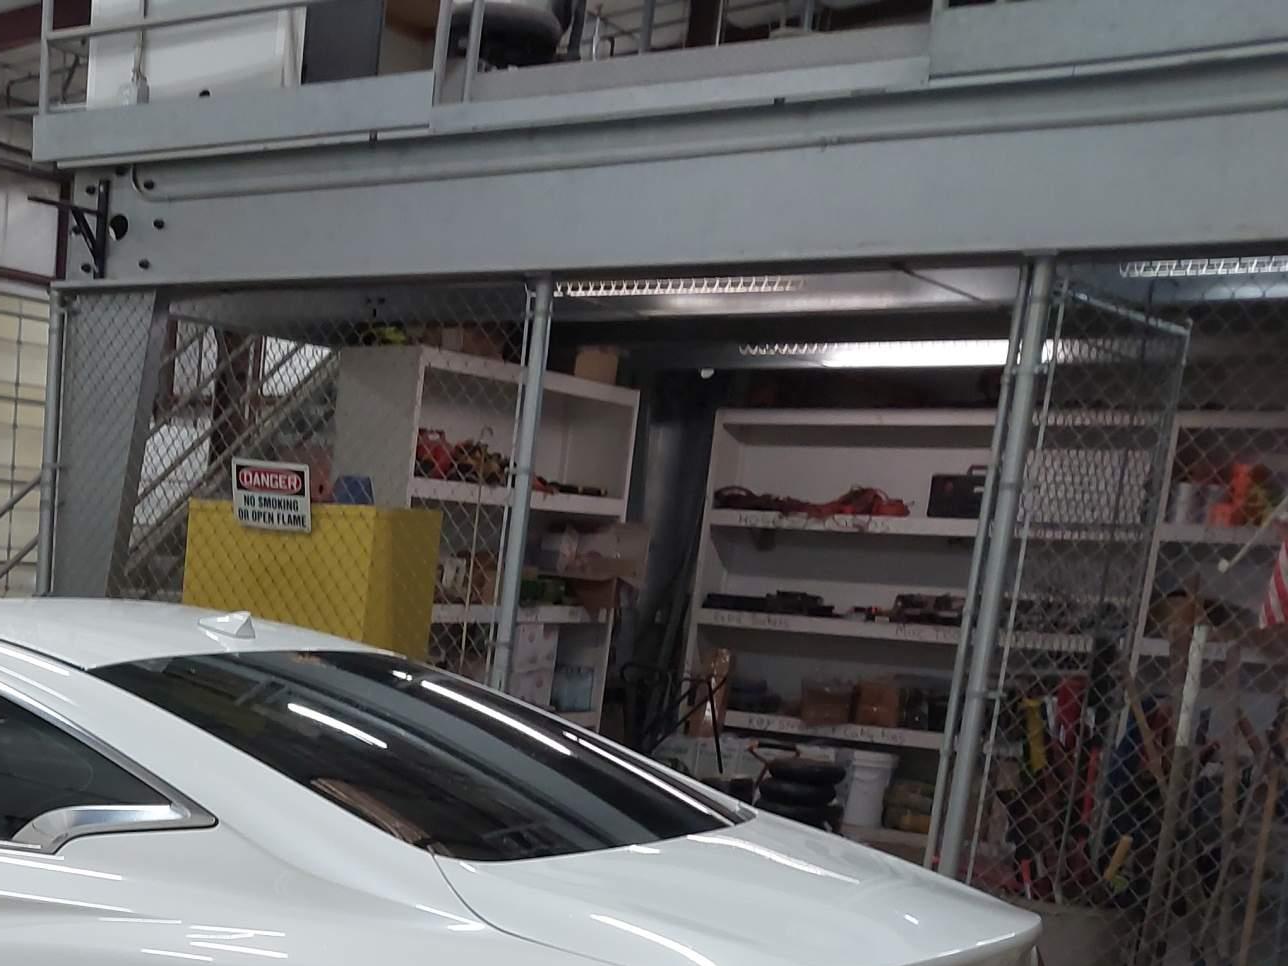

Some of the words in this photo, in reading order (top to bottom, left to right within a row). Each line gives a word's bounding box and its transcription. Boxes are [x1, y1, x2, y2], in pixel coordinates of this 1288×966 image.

[243, 471, 297, 491] DANGER
[243, 494, 256, 507] NO
[258, 496, 299, 513] SMOKING
[238, 507, 250, 521] OR
[252, 510, 275, 525] OPEN
[276, 513, 307, 528] FLAME
